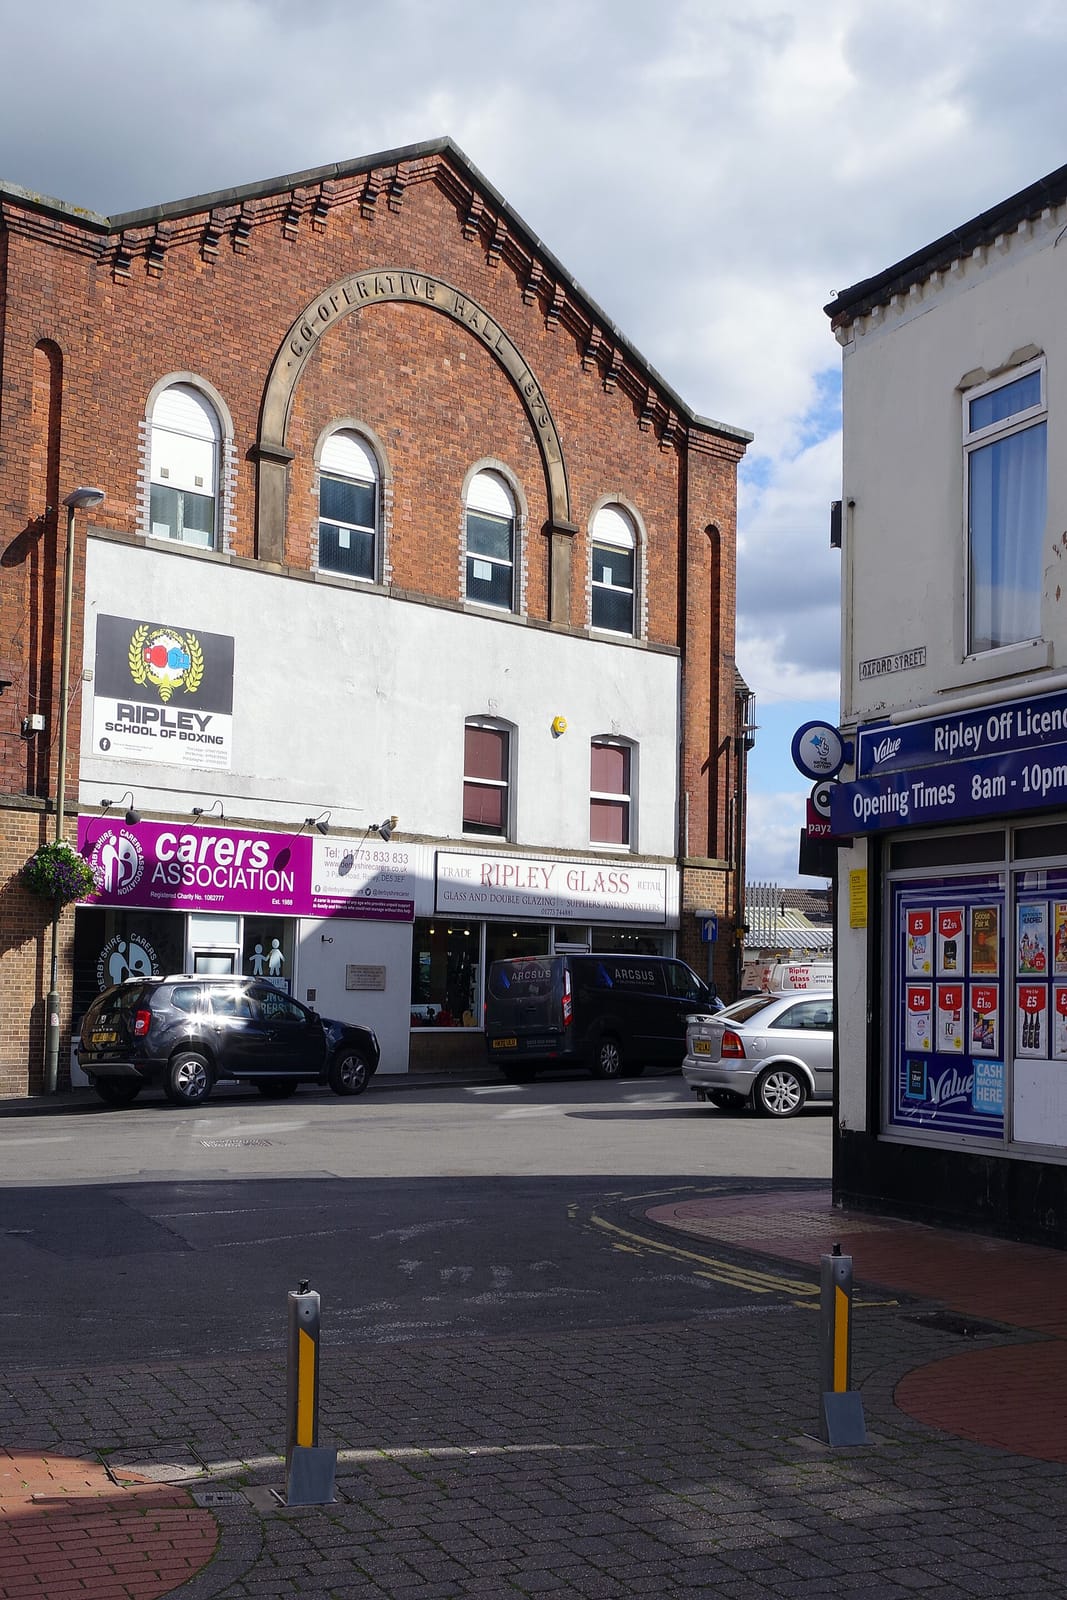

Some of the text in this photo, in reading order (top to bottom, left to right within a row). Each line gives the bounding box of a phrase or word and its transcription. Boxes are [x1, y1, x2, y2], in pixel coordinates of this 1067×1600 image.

[290, 275, 436, 358] CO-OPERATIVE
[454, 296, 503, 355] HALL
[862, 651, 924, 677] OXFORD STREET
[116, 702, 213, 732] RIPLEY
[105, 722, 224, 746] SCHOOL OF BOXING
[934, 721, 983, 755] Ripley
[986, 711, 1013, 742] Off
[873, 737, 901, 763] Value
[853, 787, 909, 823] Opening
[911, 781, 956, 809] Times
[971, 773, 1006, 801] 8am
[1021, 764, 1067, 797] 10pm
[808, 823, 831, 835] payz
[119, 828, 143, 854] CARERS
[155, 832, 270, 868] carers
[325, 846, 409, 864] Tel: 01773 833 833
[117, 854, 145, 896] ASSOCIATION
[151, 862, 294, 893] ASSOCIATION
[442, 866, 472, 878] TRADE
[480, 862, 630, 894] RIPLEY GLASS
[637, 881, 662, 891] RETAIL
[150, 891, 176, 899] Registered
[177, 892, 194, 901] Charity
[443, 890, 660, 911] GLASS AND DOUBLE GLAZING SUPPLIERS AND INSTALLERS
[914, 919, 924, 930] £5
[130, 932, 157, 961] CARERS
[511, 969, 552, 981] ARCSUS
[614, 968, 655, 981] ARCSUS
[788, 967, 809, 975] Ripley
[913, 995, 925, 1006] £14
[945, 993, 954, 1004] £1
[1026, 996, 1037, 1007] £5
[976, 1063, 1003, 1078] CASH
[928, 1068, 974, 1105] Value
[976, 1077, 1003, 1088] MACHINE
[976, 1086, 1003, 1103] HERE
